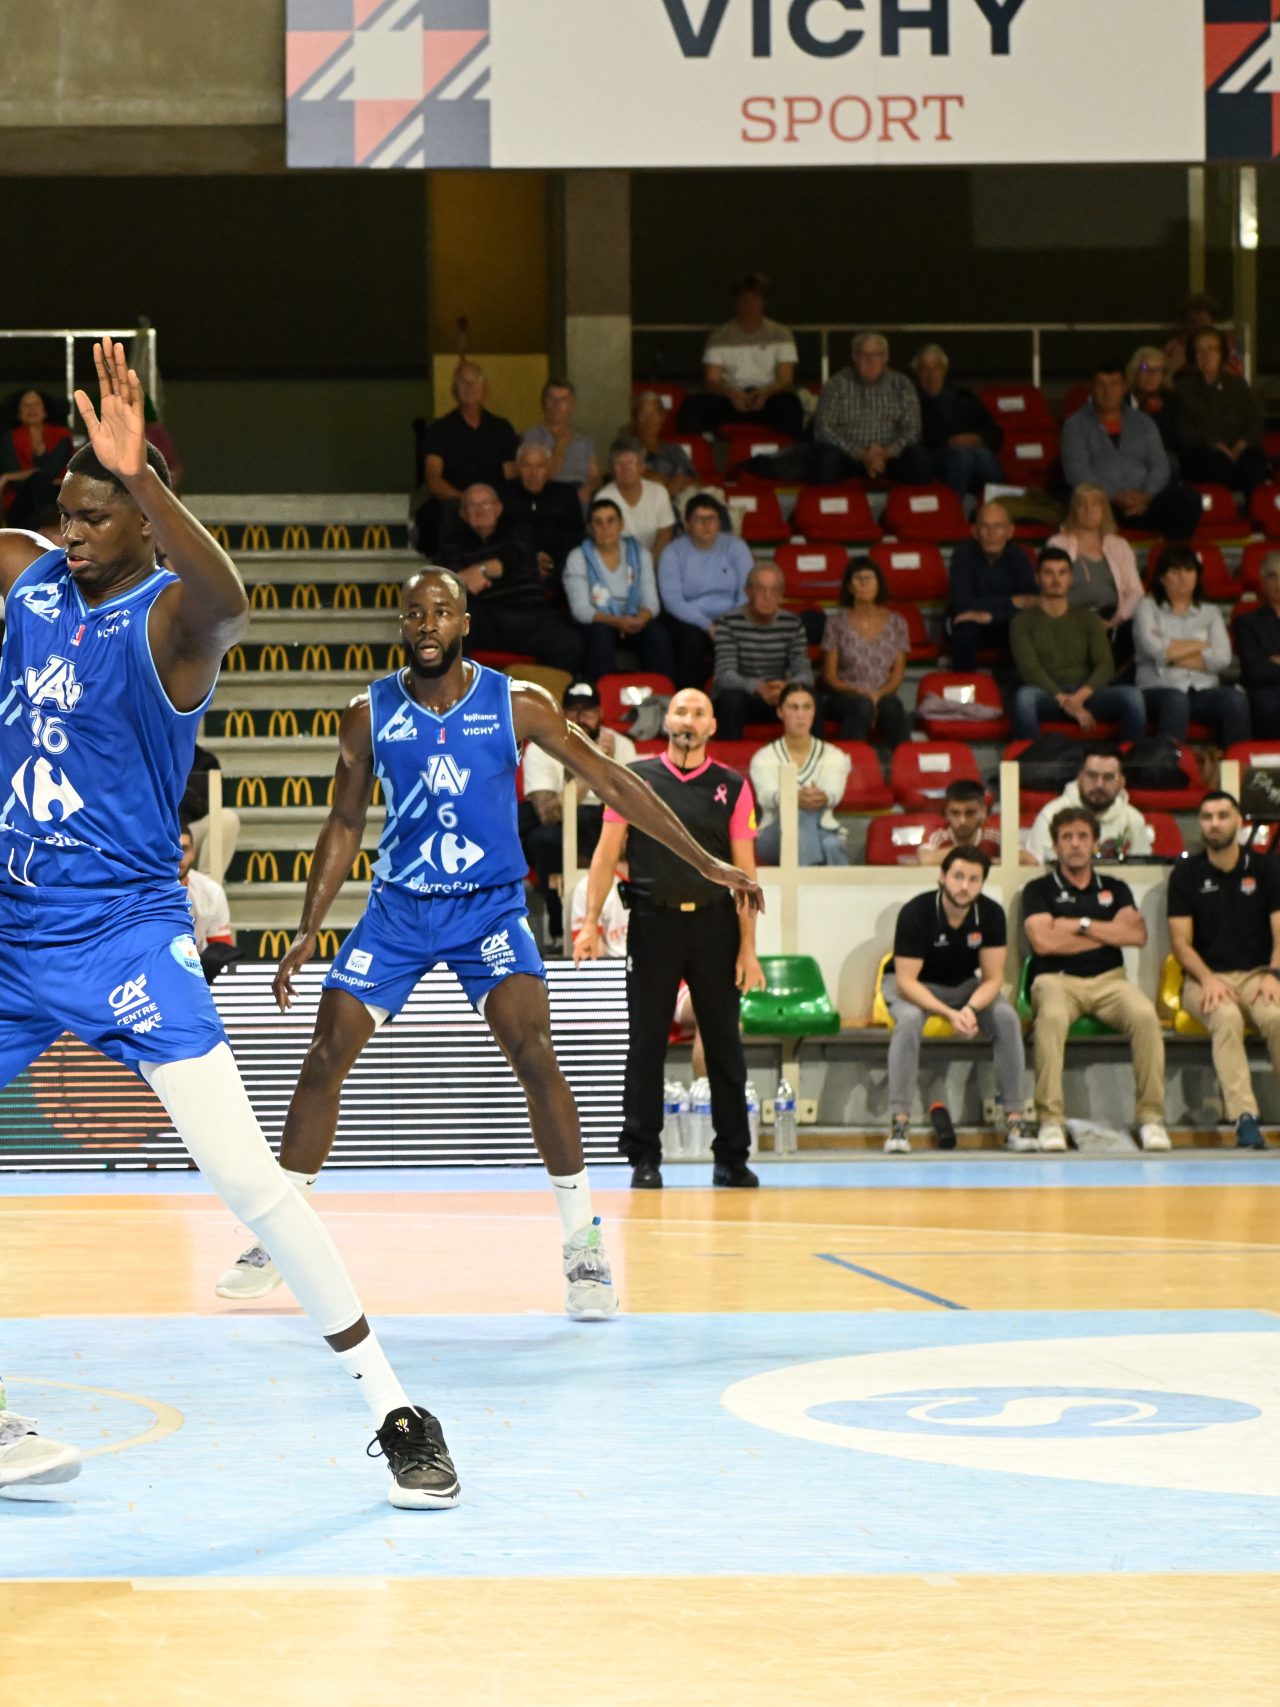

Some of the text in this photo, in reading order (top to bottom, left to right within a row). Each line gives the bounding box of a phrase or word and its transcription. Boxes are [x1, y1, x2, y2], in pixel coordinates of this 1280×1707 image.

[662, 0, 1022, 59] VICHY
[740, 94, 965, 143] SPORT
[30, 708, 69, 754] 16
[462, 726, 494, 736] VICHY
[437, 802, 458, 829] 6
[331, 969, 379, 989] Groupam
[116, 1002, 158, 1026] CENTRE
